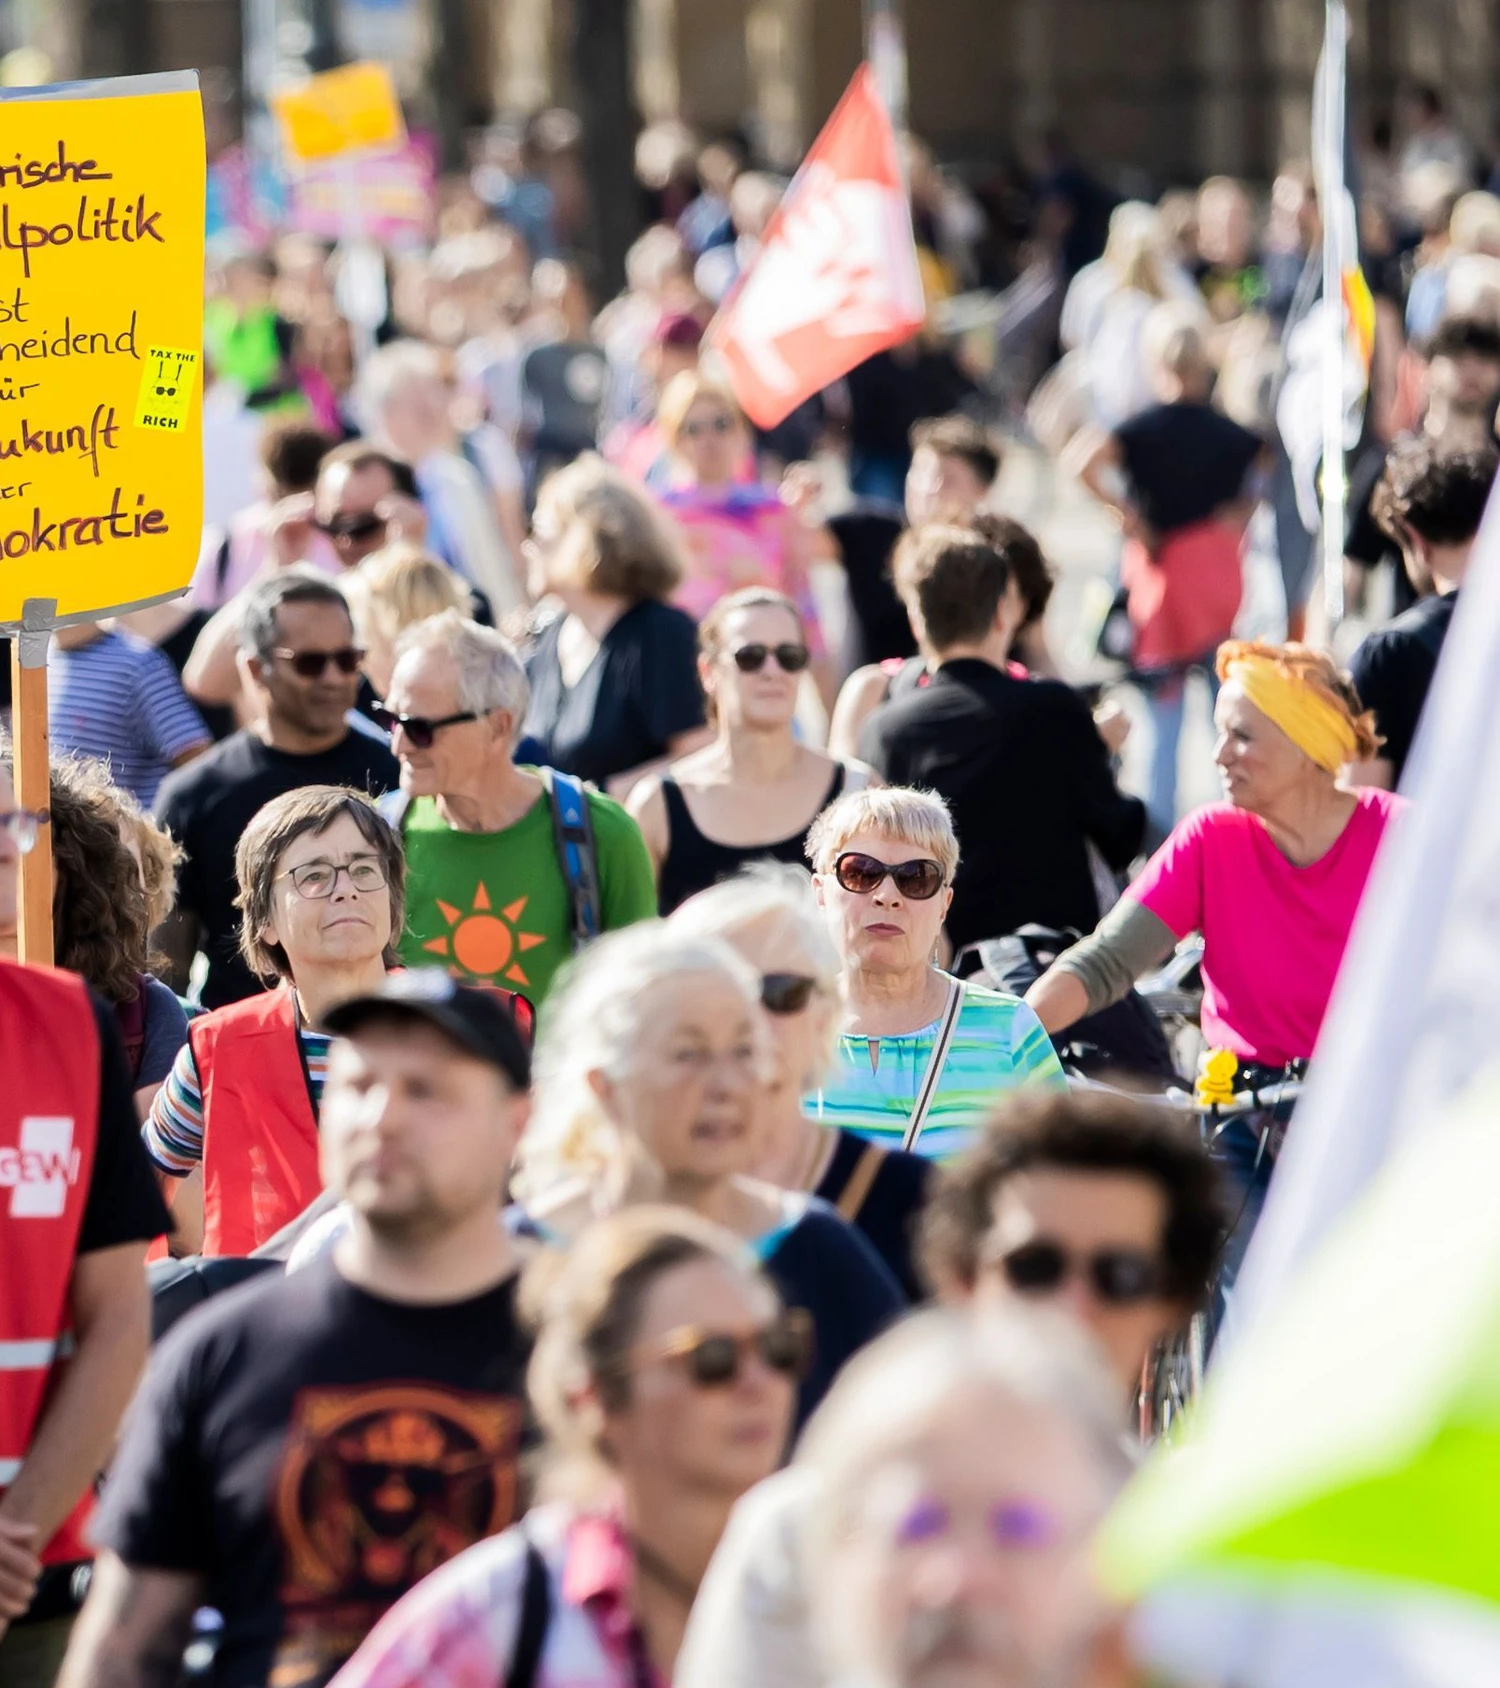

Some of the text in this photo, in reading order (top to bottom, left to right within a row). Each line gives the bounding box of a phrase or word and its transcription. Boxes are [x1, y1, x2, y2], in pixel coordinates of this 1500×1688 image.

[150, 349, 196, 362] TAX THE
[142, 415, 179, 429] RICH
